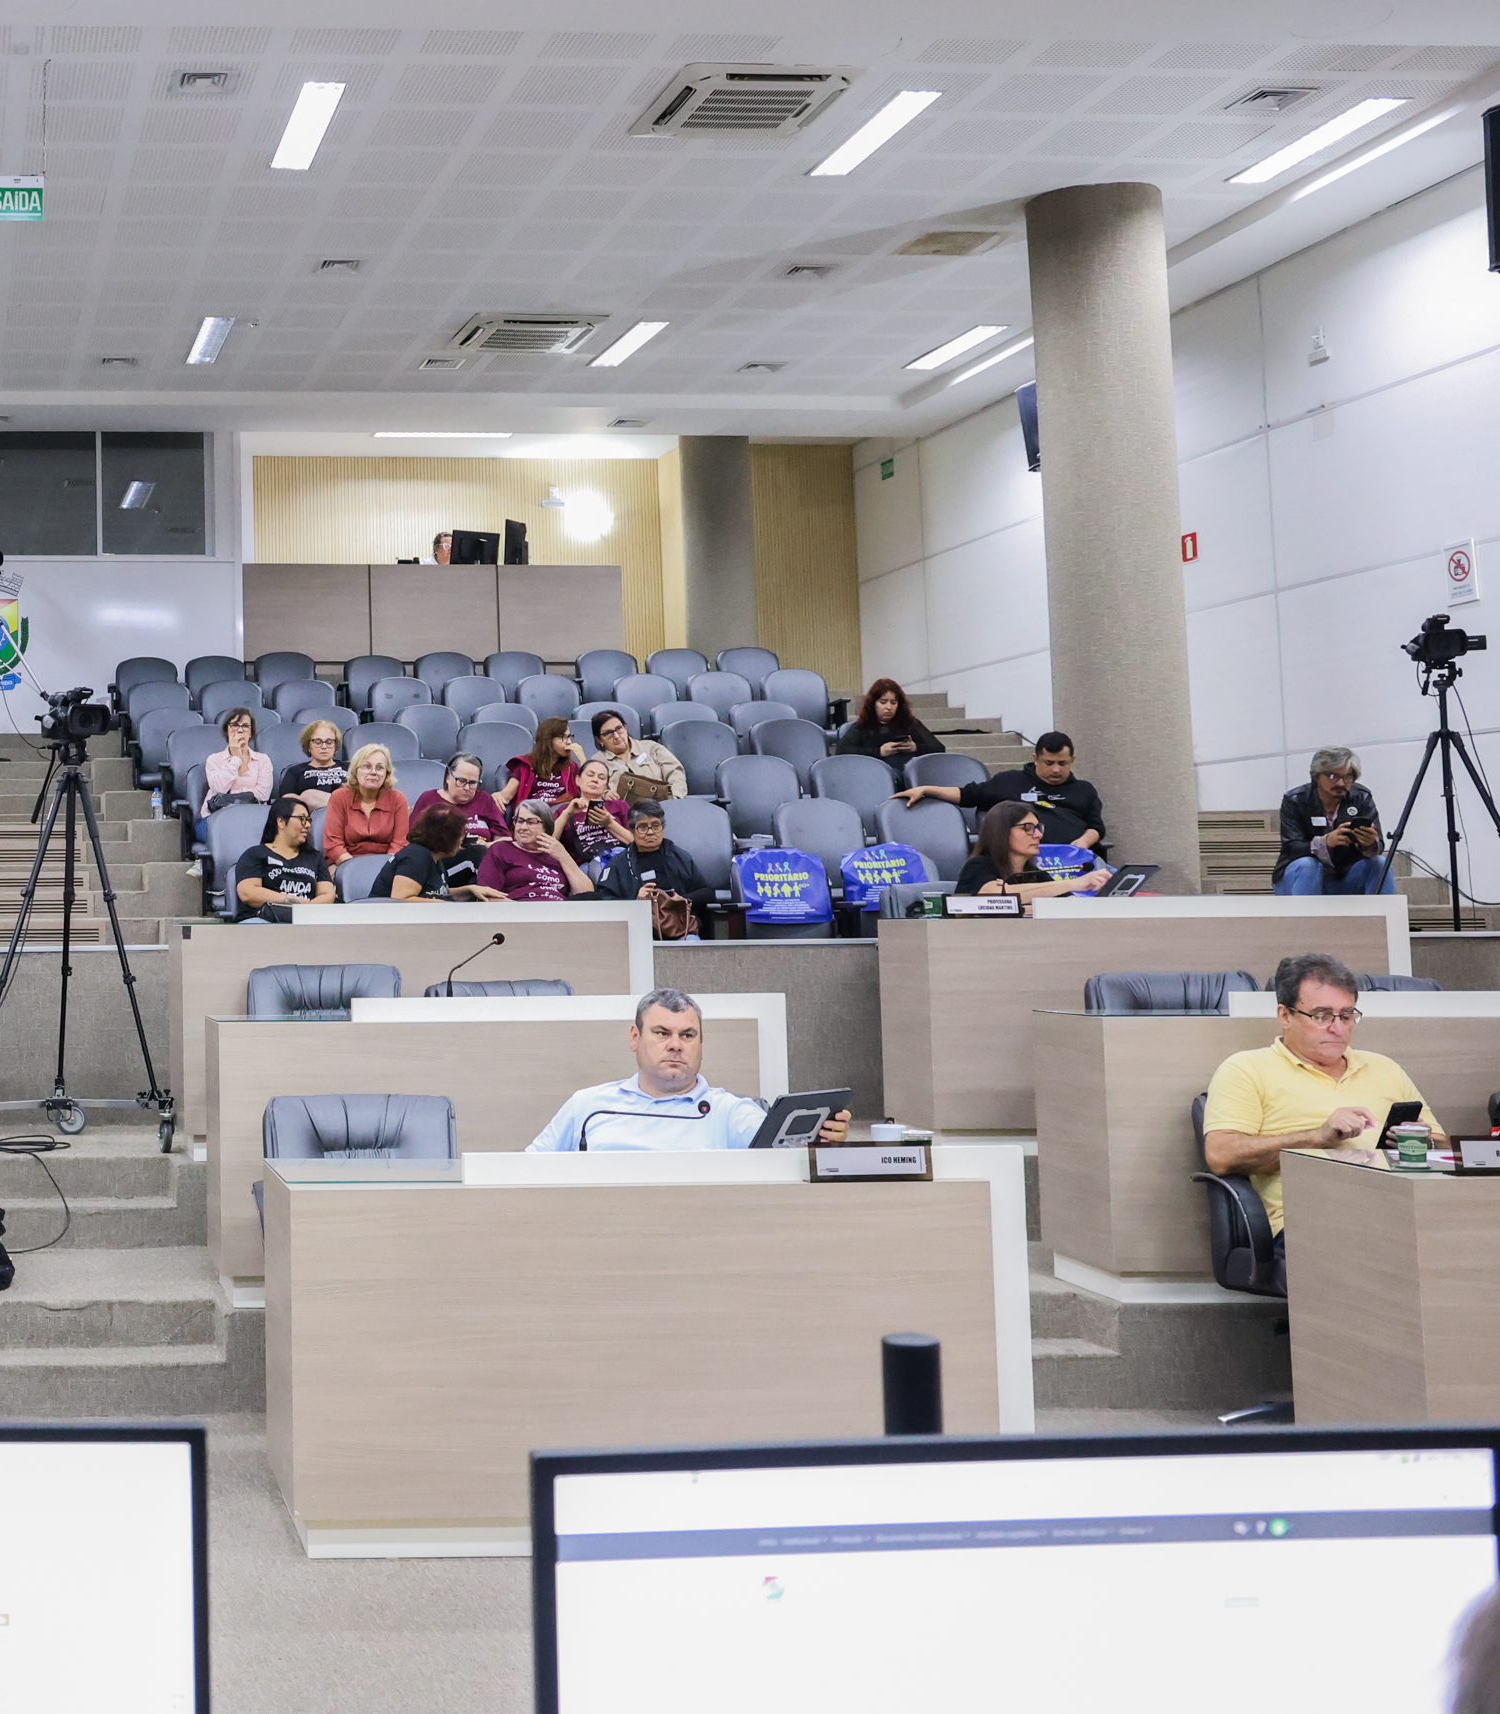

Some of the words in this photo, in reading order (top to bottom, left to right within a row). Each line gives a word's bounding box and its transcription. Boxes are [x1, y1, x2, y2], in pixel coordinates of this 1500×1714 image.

[279, 879, 312, 893] AINDA
[881, 1156, 892, 1164] ICO
[893, 1156, 917, 1164] HEMING
